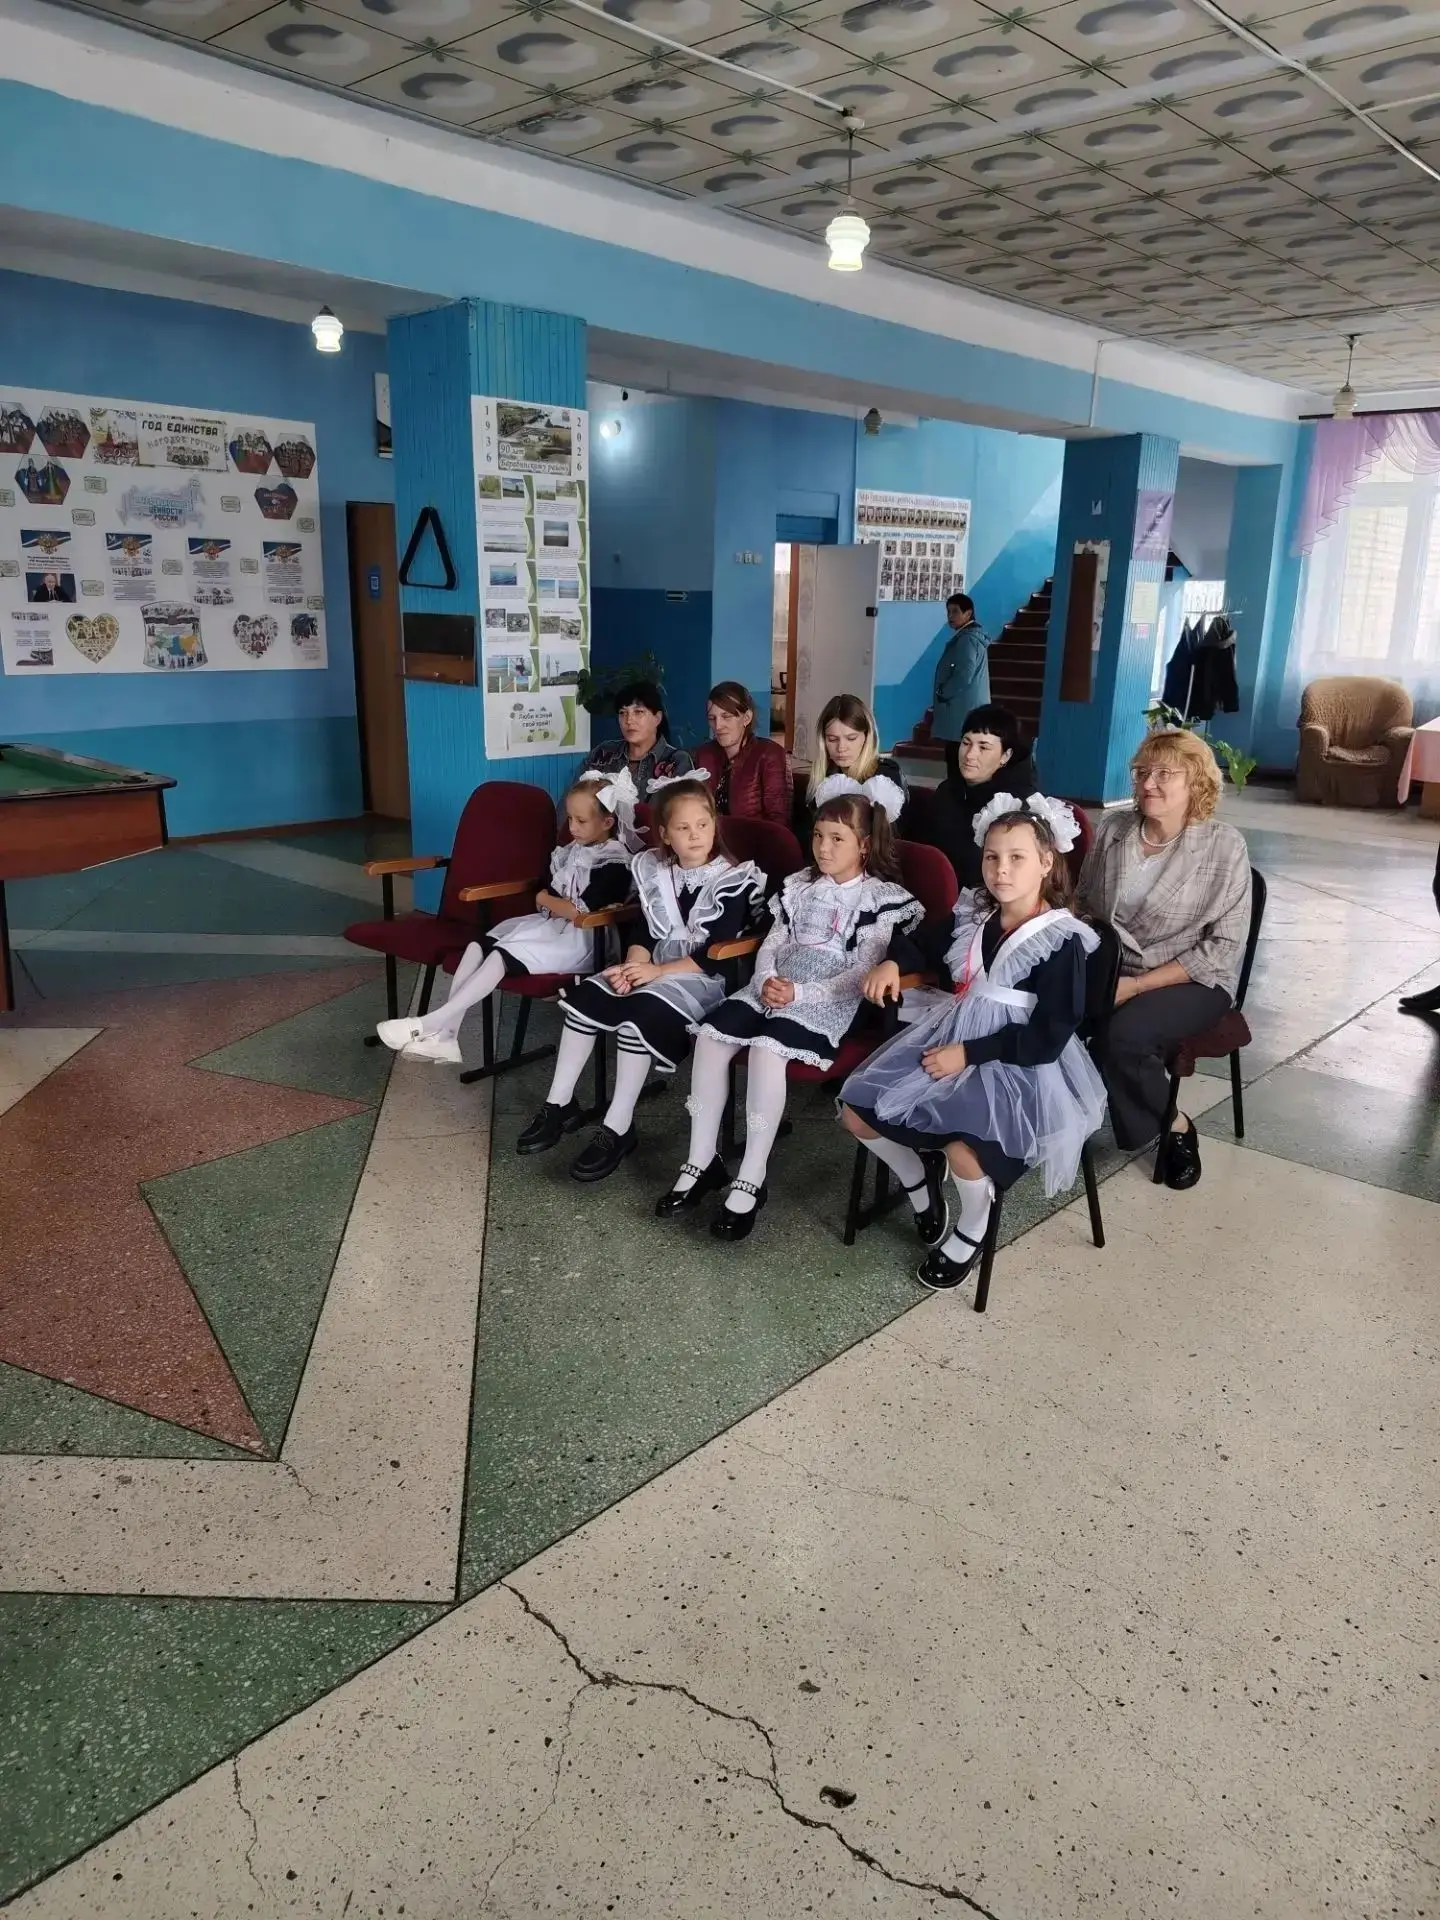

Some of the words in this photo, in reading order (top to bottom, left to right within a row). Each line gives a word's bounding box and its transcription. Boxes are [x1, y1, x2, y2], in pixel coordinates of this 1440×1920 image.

[142, 420, 162, 432] ГОД
[167, 422, 218, 436] ЕДИНСТВА
[500, 443, 511, 454] 90
